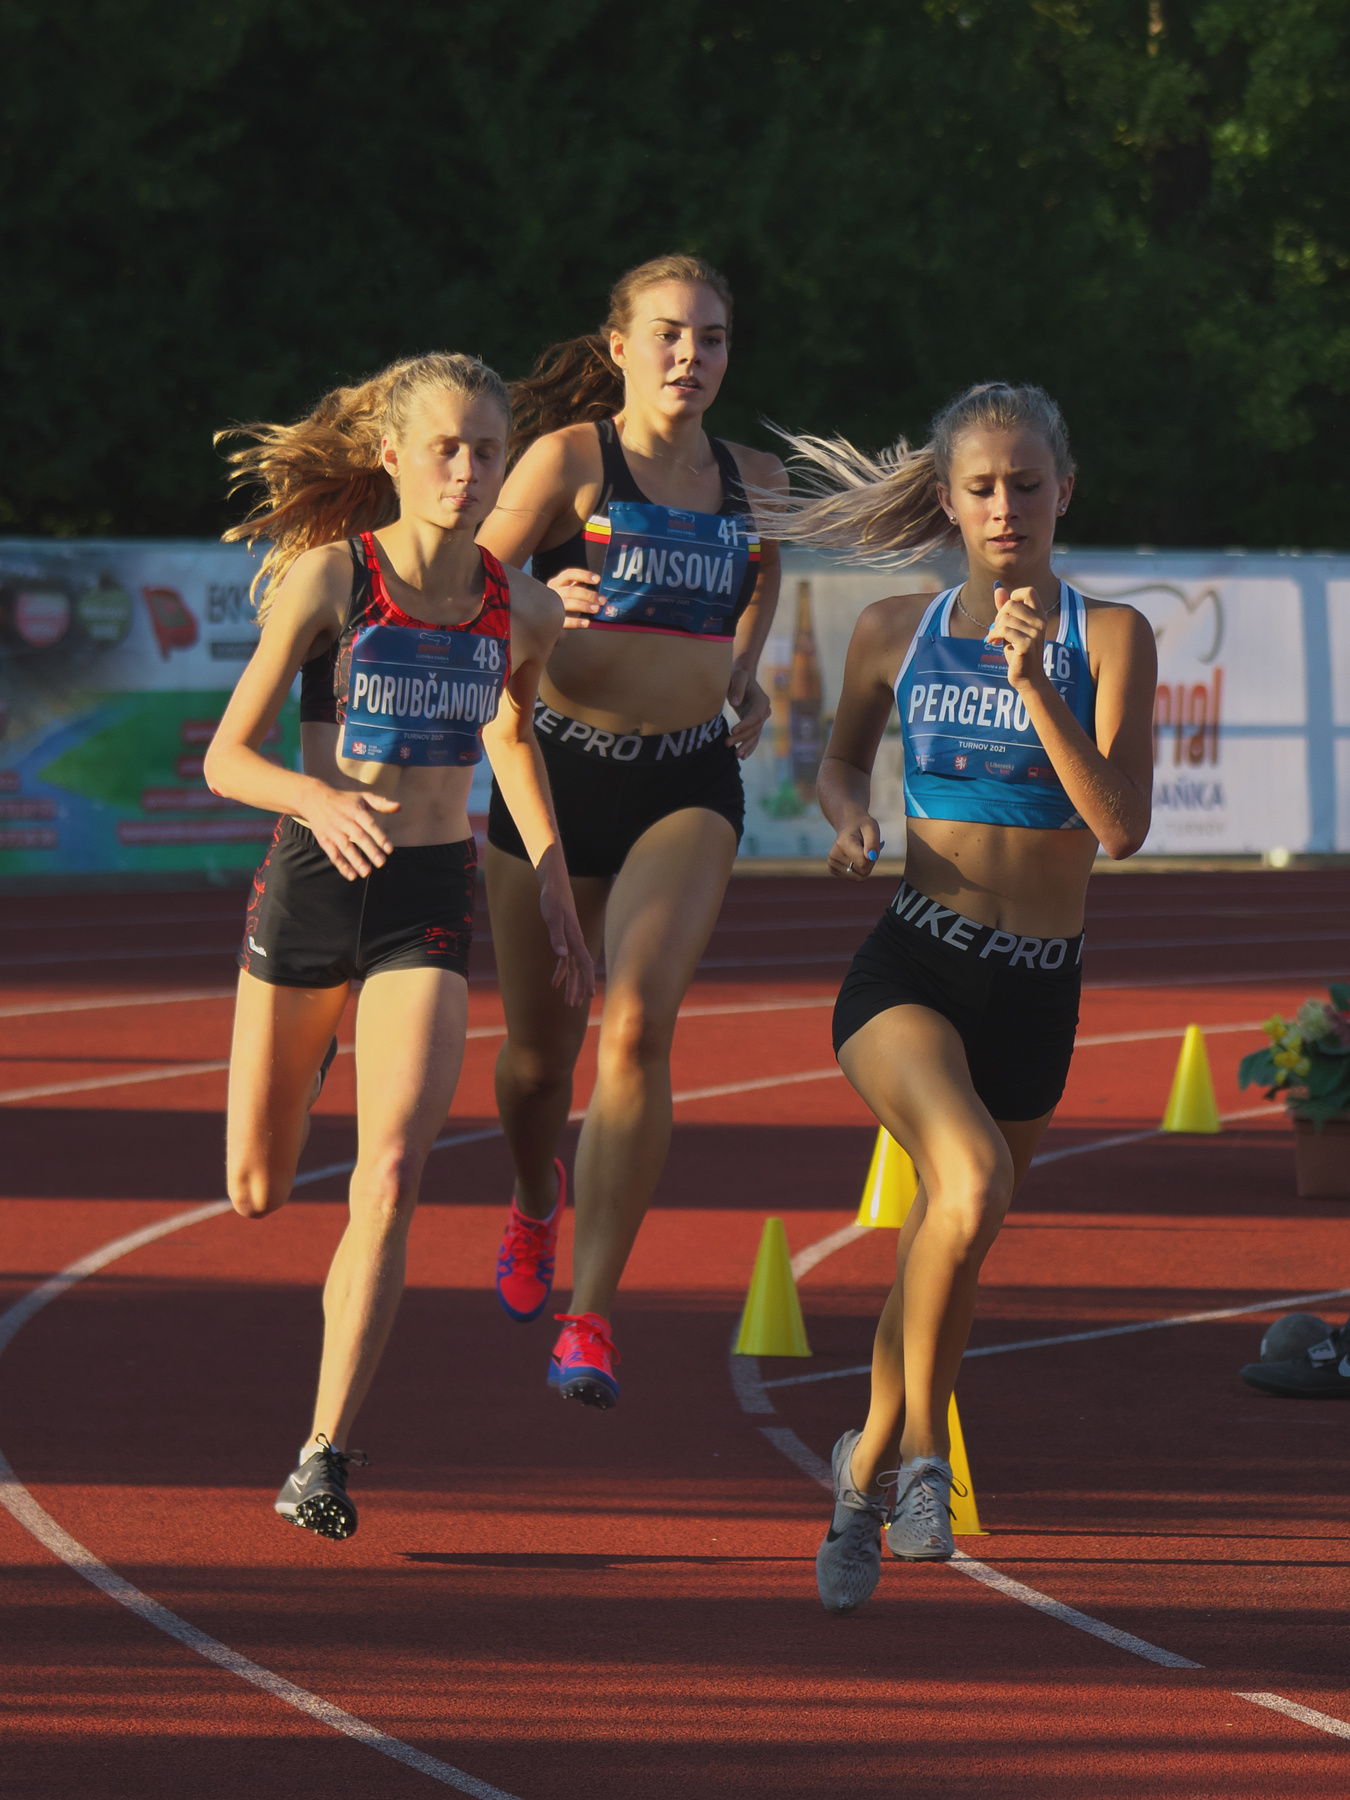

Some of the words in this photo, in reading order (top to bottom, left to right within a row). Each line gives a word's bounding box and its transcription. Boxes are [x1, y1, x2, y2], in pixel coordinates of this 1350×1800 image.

[717, 518, 738, 547] 41
[612, 545, 734, 595] JANSOVÁ
[472, 638, 500, 671] 48
[1043, 644, 1070, 679] 46
[353, 672, 499, 723] PORUBČANOVÁ
[908, 683, 1068, 732] PERGERO
[403, 732, 430, 741] TURNOV
[560, 720, 643, 761] PRO
[958, 740, 989, 751] TURNOV
[989, 745, 1006, 753] 2021
[1154, 774, 1225, 809] AŇKA
[890, 880, 984, 951] NIKE
[978, 929, 1068, 970] PRO
